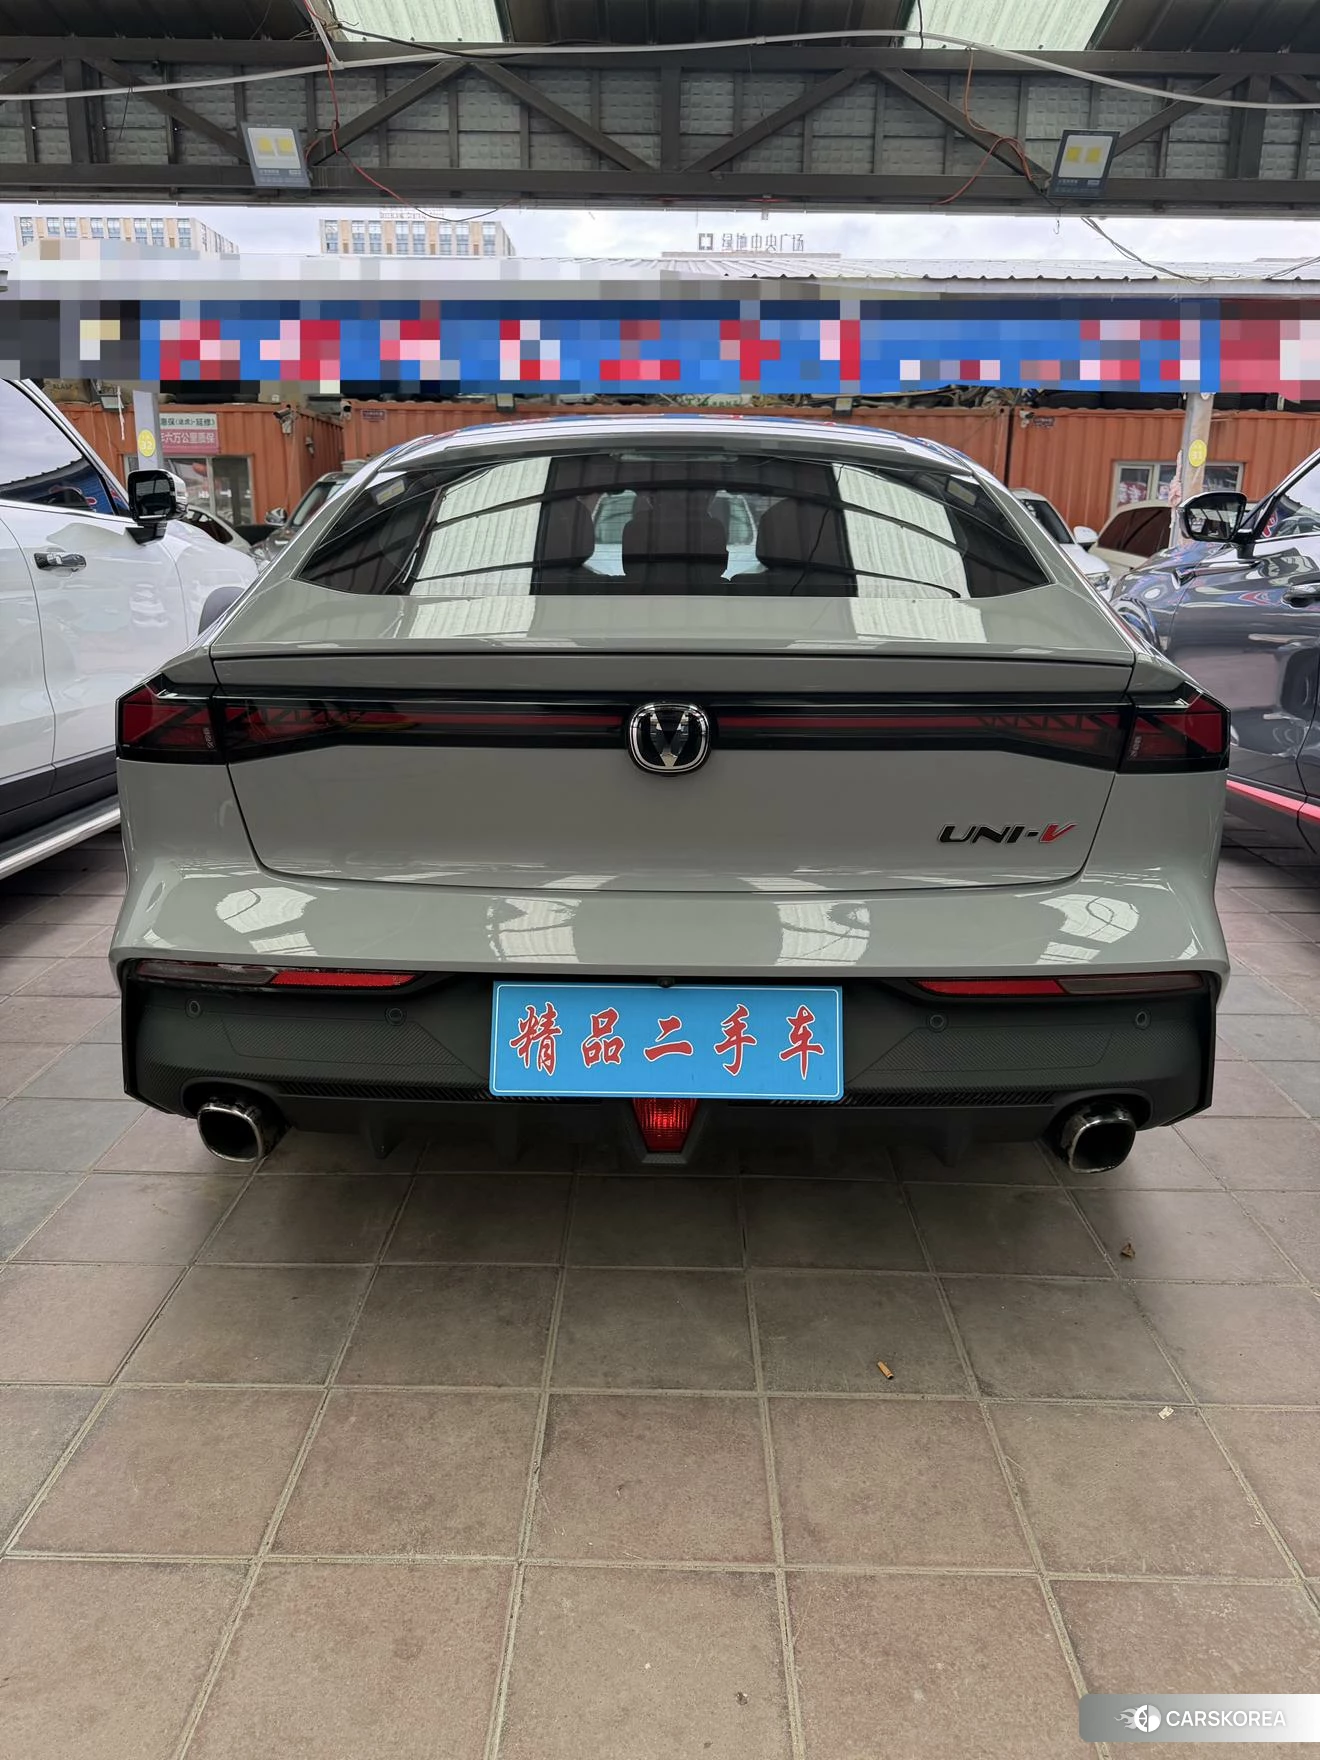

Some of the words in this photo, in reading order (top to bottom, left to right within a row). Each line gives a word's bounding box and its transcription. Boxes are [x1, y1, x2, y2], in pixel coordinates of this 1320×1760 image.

[722, 233, 804, 251] 绿地中央广场
[938, 823, 1078, 843] UNI-V
[509, 1001, 824, 1080] 精品二手车
